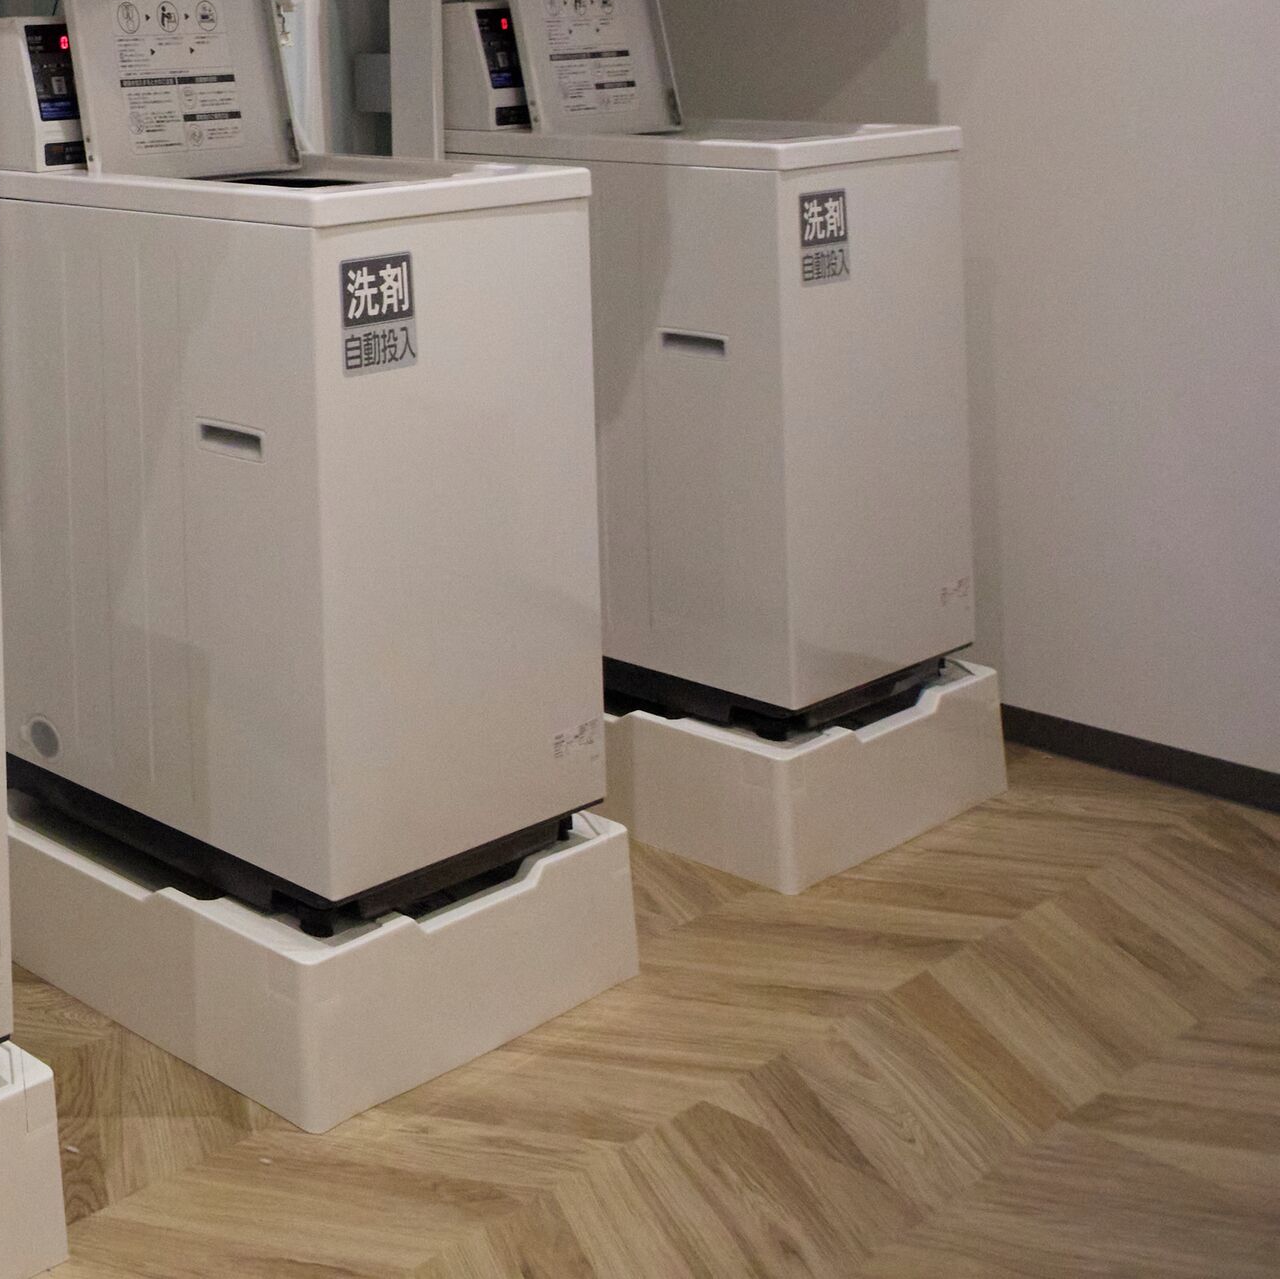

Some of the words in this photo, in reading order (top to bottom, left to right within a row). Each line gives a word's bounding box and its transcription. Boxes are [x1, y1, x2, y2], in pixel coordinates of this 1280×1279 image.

[803, 196, 845, 241] 洗剤
[347, 261, 410, 320] 洗剤
[344, 326, 416, 370] 自動投入
